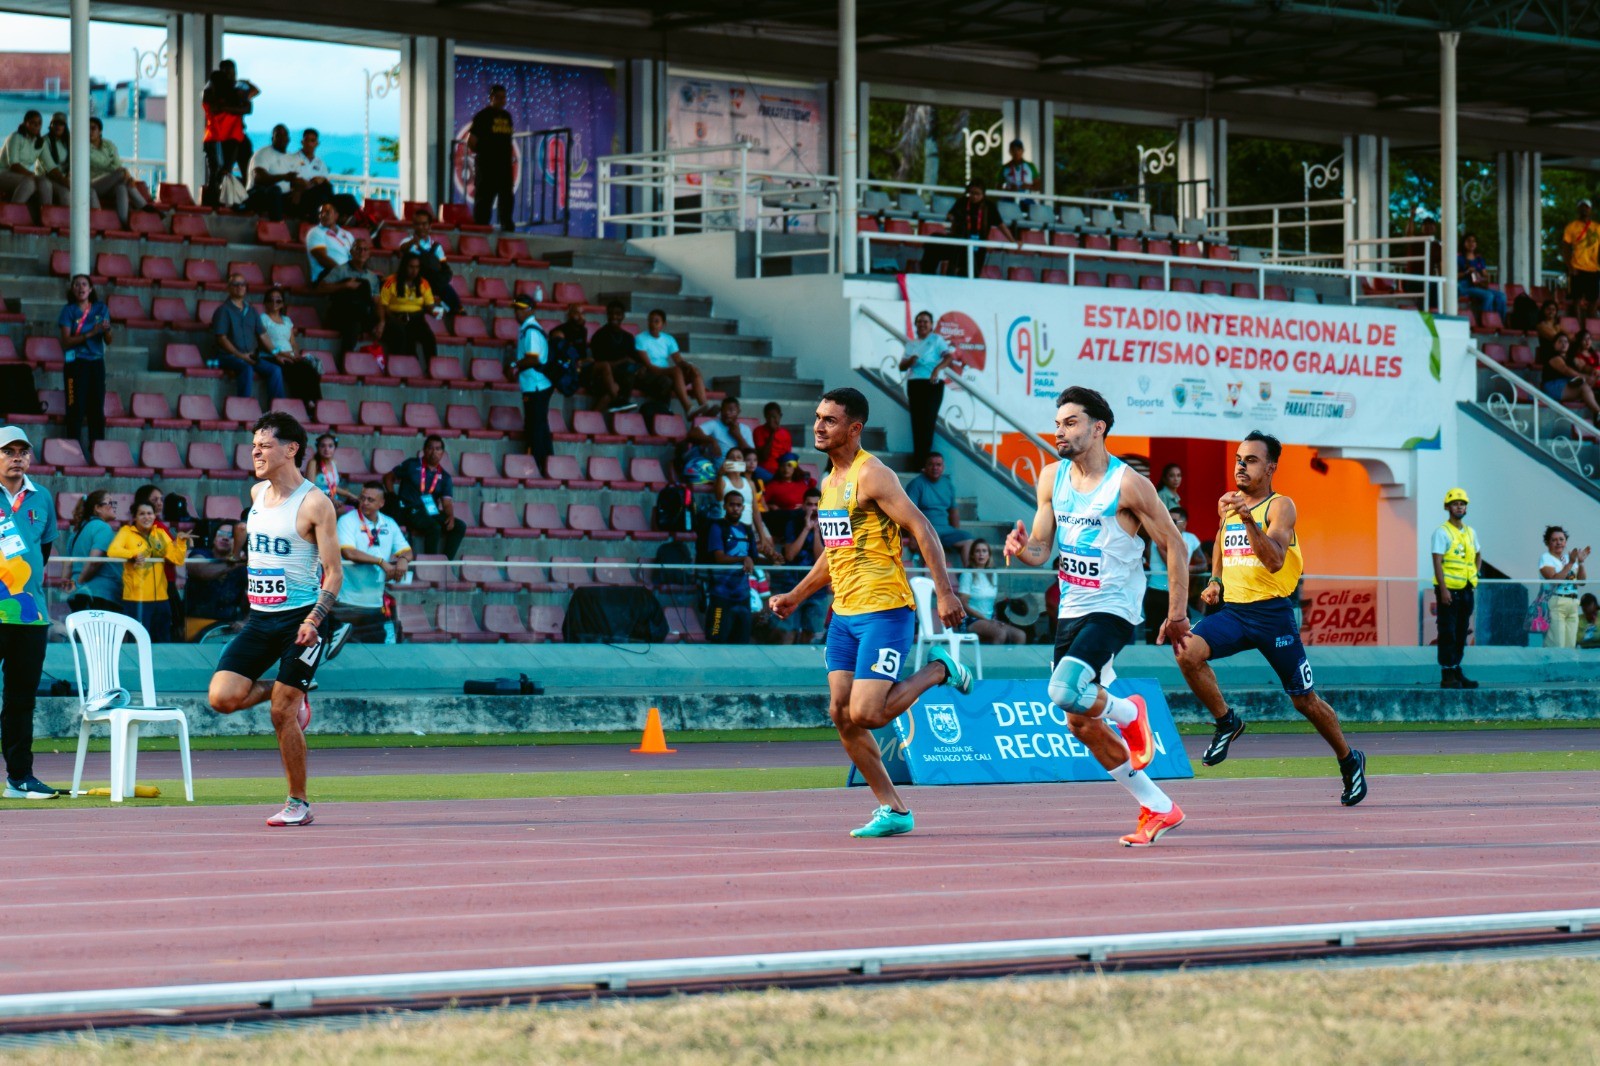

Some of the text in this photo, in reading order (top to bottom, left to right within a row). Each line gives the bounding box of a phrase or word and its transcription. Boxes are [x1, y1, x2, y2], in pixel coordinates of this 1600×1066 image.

[1083, 304, 1397, 346] ESTADIO INTERNACIONAL DE
[1077, 337, 1403, 378] ATLETISMO PEDRO GRAJALES
[1034, 378, 1055, 387] PARA
[1034, 388, 1061, 399] Siempr
[1127, 396, 1165, 408] Deporte
[1284, 401, 1345, 418] PARAATLETISMO
[1057, 515, 1102, 527] ARGENTINA
[1060, 554, 1100, 577] 6305
[1316, 590, 1371, 606] Cali es
[1309, 606, 1376, 630] PARA
[883, 651, 897, 673] 5
[1303, 664, 1312, 684] 6
[934, 745, 964, 753] ALCALDÍA
[922, 753, 992, 762] SANTIAGO DE CALI
